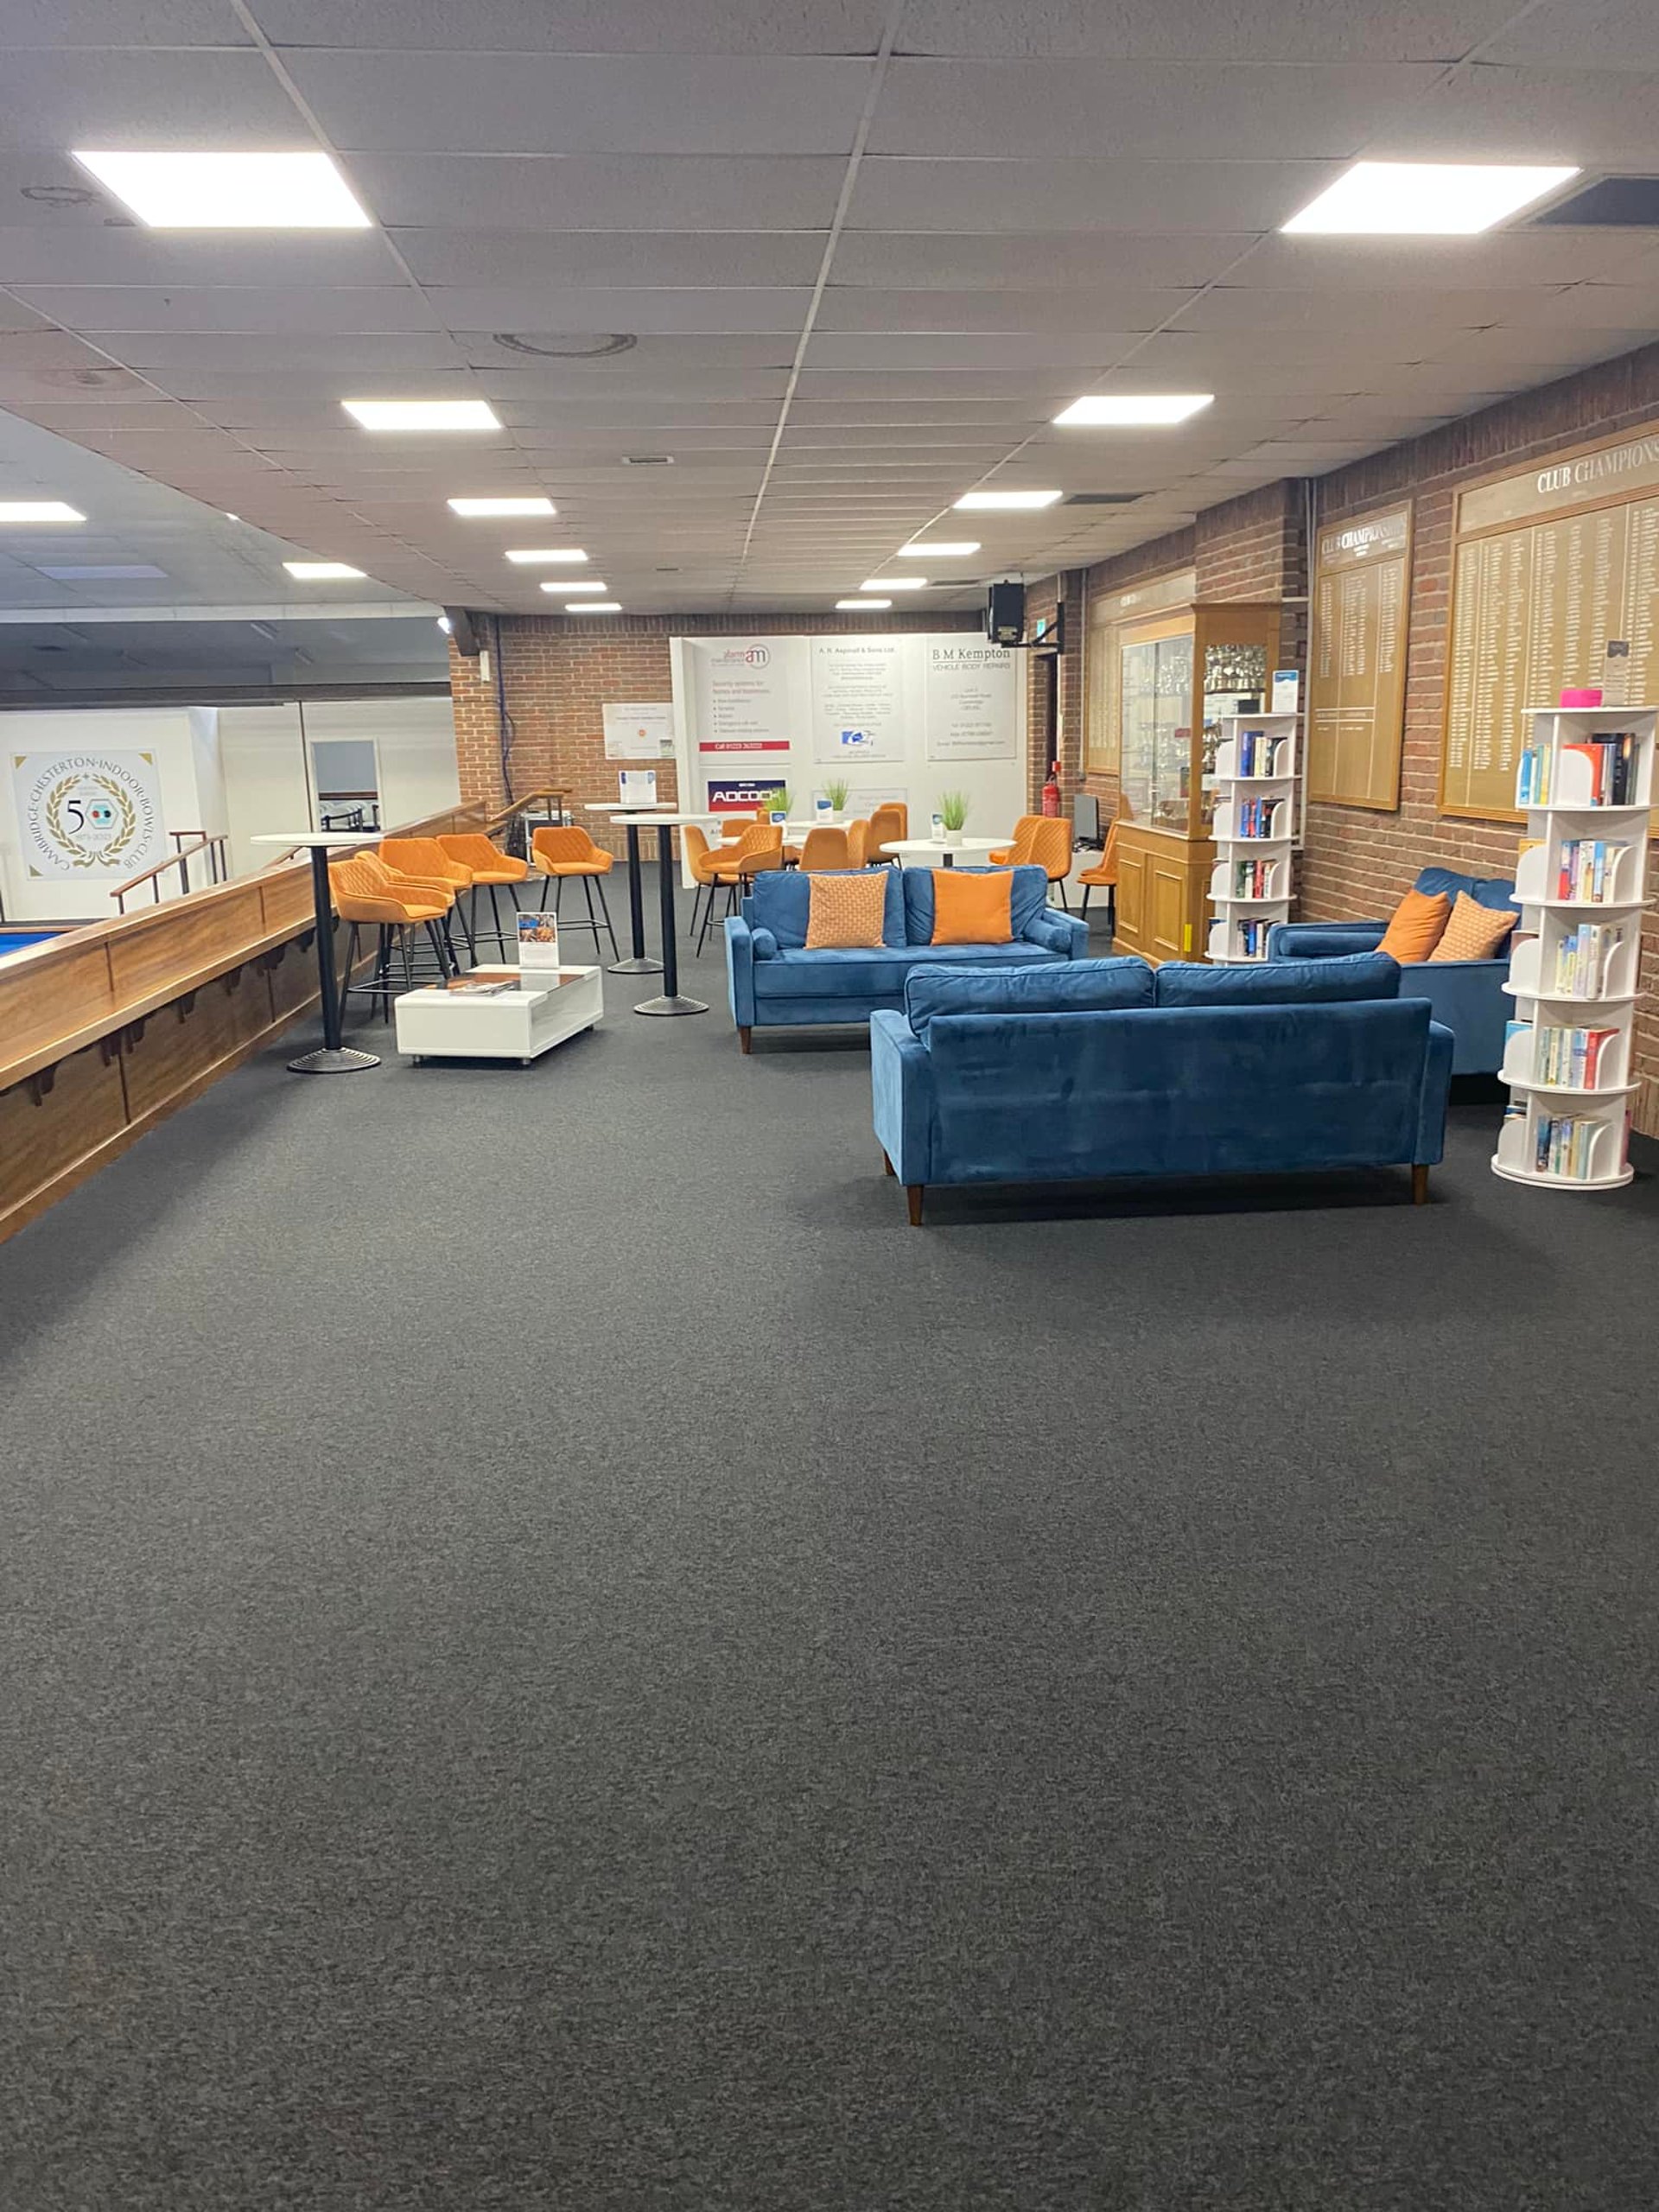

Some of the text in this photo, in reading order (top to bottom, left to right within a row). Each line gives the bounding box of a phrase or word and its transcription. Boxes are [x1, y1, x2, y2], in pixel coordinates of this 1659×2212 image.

[1537, 467, 1571, 493] CLUB
[933, 648, 1011, 662] B M Kempton
[29, 757, 95, 803] CHESTERTON
[99, 760, 145, 798] INDOOR
[140, 798, 155, 840] BOWLS
[124, 842, 148, 869] CLUB
